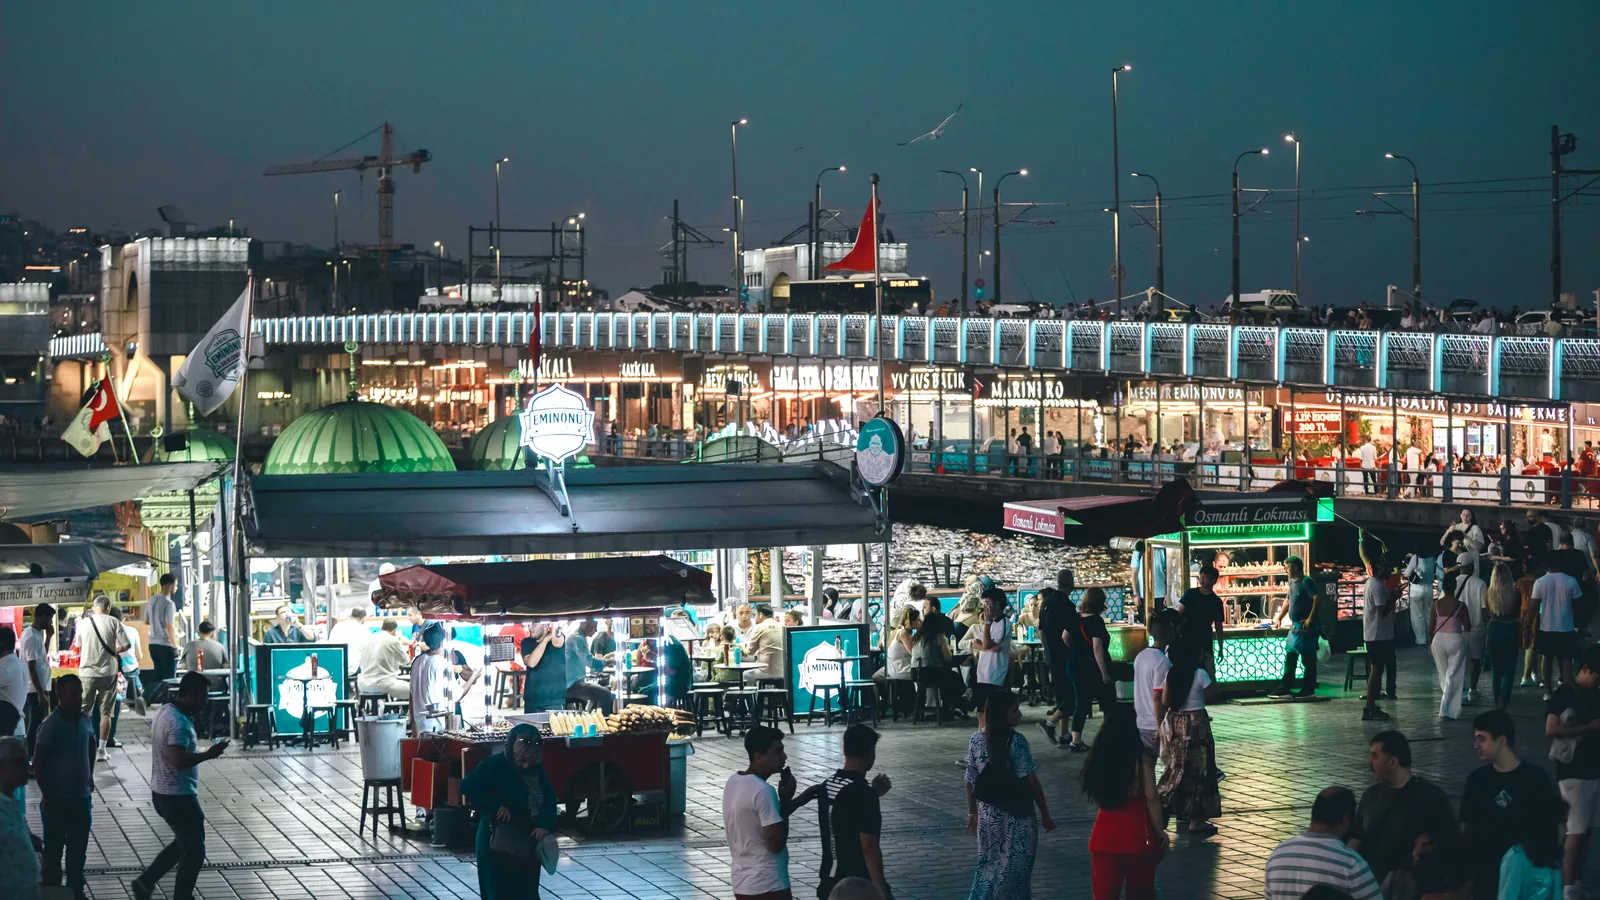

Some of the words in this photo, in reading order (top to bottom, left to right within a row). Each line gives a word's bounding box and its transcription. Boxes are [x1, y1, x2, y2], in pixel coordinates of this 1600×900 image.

[1284, 412, 1311, 422] BLIK
[1530, 407, 1576, 422] EKME
[1194, 507, 1249, 523] Osmanlı
